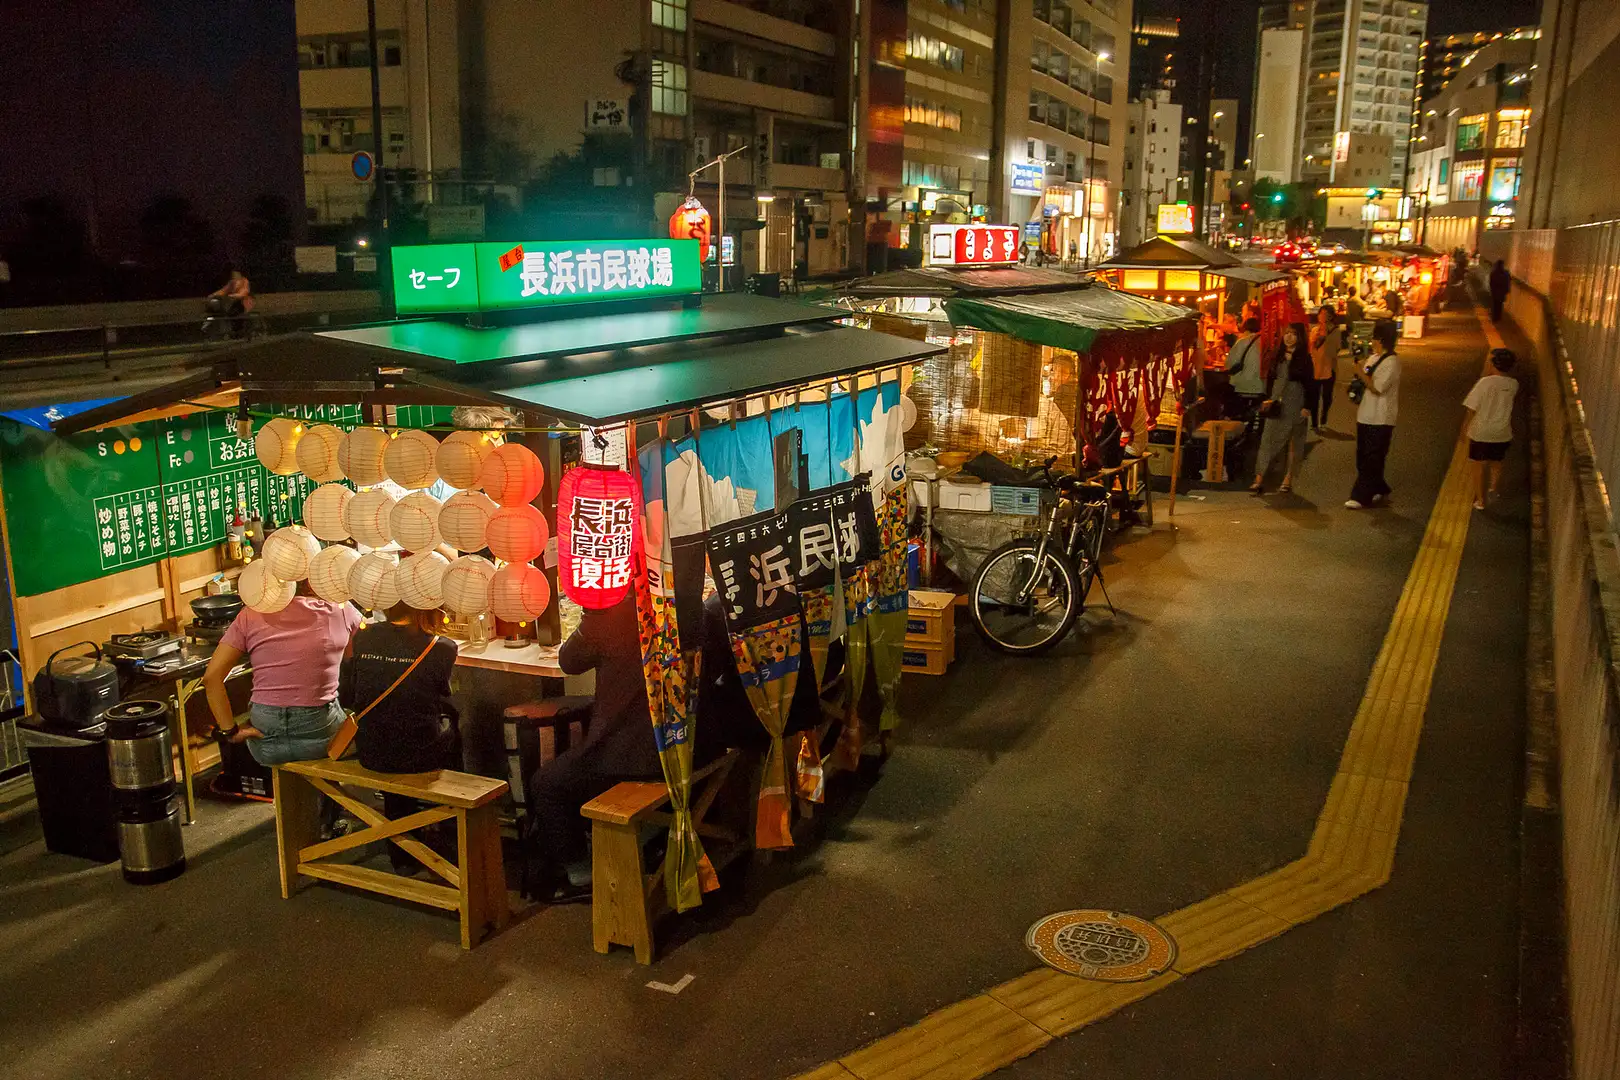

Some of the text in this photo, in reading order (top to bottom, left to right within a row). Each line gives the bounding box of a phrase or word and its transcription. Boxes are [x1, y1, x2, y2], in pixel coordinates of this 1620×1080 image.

[408, 267, 461, 290] セーフ
[519, 247, 673, 297] 長浜市民球場
[98, 442, 107, 457] S
[166, 431, 175, 445] E
[169, 454, 182, 468] Fc
[98, 507, 116, 558] 炒め物
[118, 507, 132, 554] 野菜炒め
[132, 503, 147, 551] 豚キムチ
[147, 500, 162, 548] 焼きそば
[569, 495, 634, 535] 長浜
[571, 532, 633, 560] 屋台街
[571, 557, 632, 589] 復活
